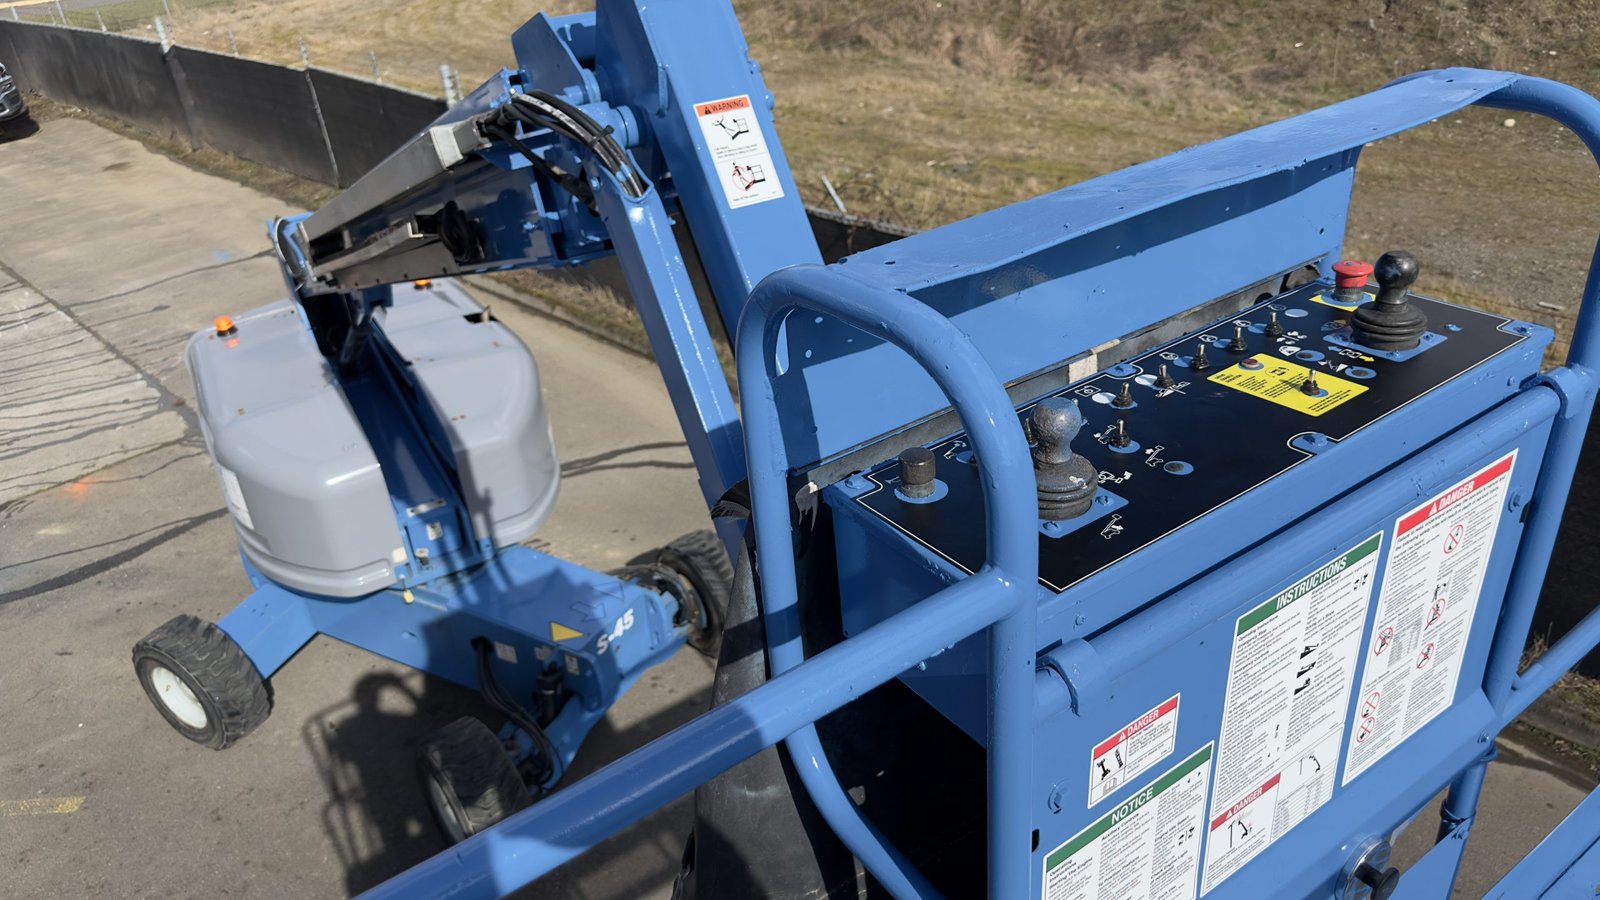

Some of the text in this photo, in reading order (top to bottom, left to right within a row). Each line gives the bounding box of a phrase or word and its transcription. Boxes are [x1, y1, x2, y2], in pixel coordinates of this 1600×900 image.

[712, 100, 744, 113] WARNING
[1438, 480, 1475, 511] DANGER
[1276, 556, 1347, 610] INSTRUCTIONS
[1127, 710, 1159, 736] DANGER
[1111, 787, 1155, 825] NOTICE
[1232, 788, 1263, 815] DANGER
